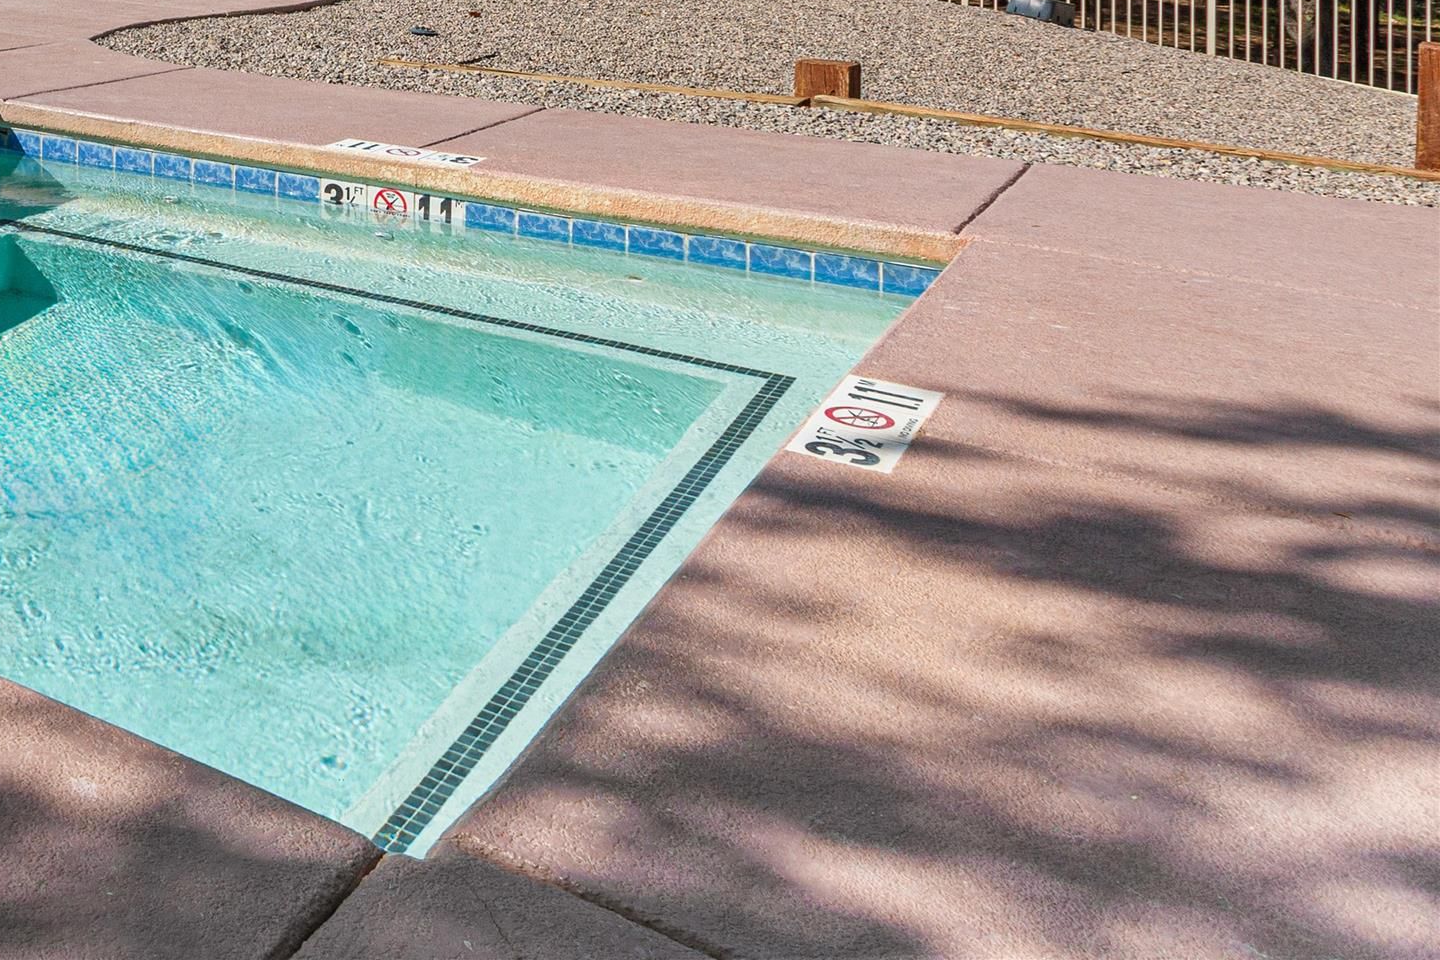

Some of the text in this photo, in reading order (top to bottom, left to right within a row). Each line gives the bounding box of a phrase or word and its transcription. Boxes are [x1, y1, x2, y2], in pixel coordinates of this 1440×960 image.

[354, 187, 364, 196] FT
[816, 426, 836, 435] FT
[804, 441, 881, 466] 3
